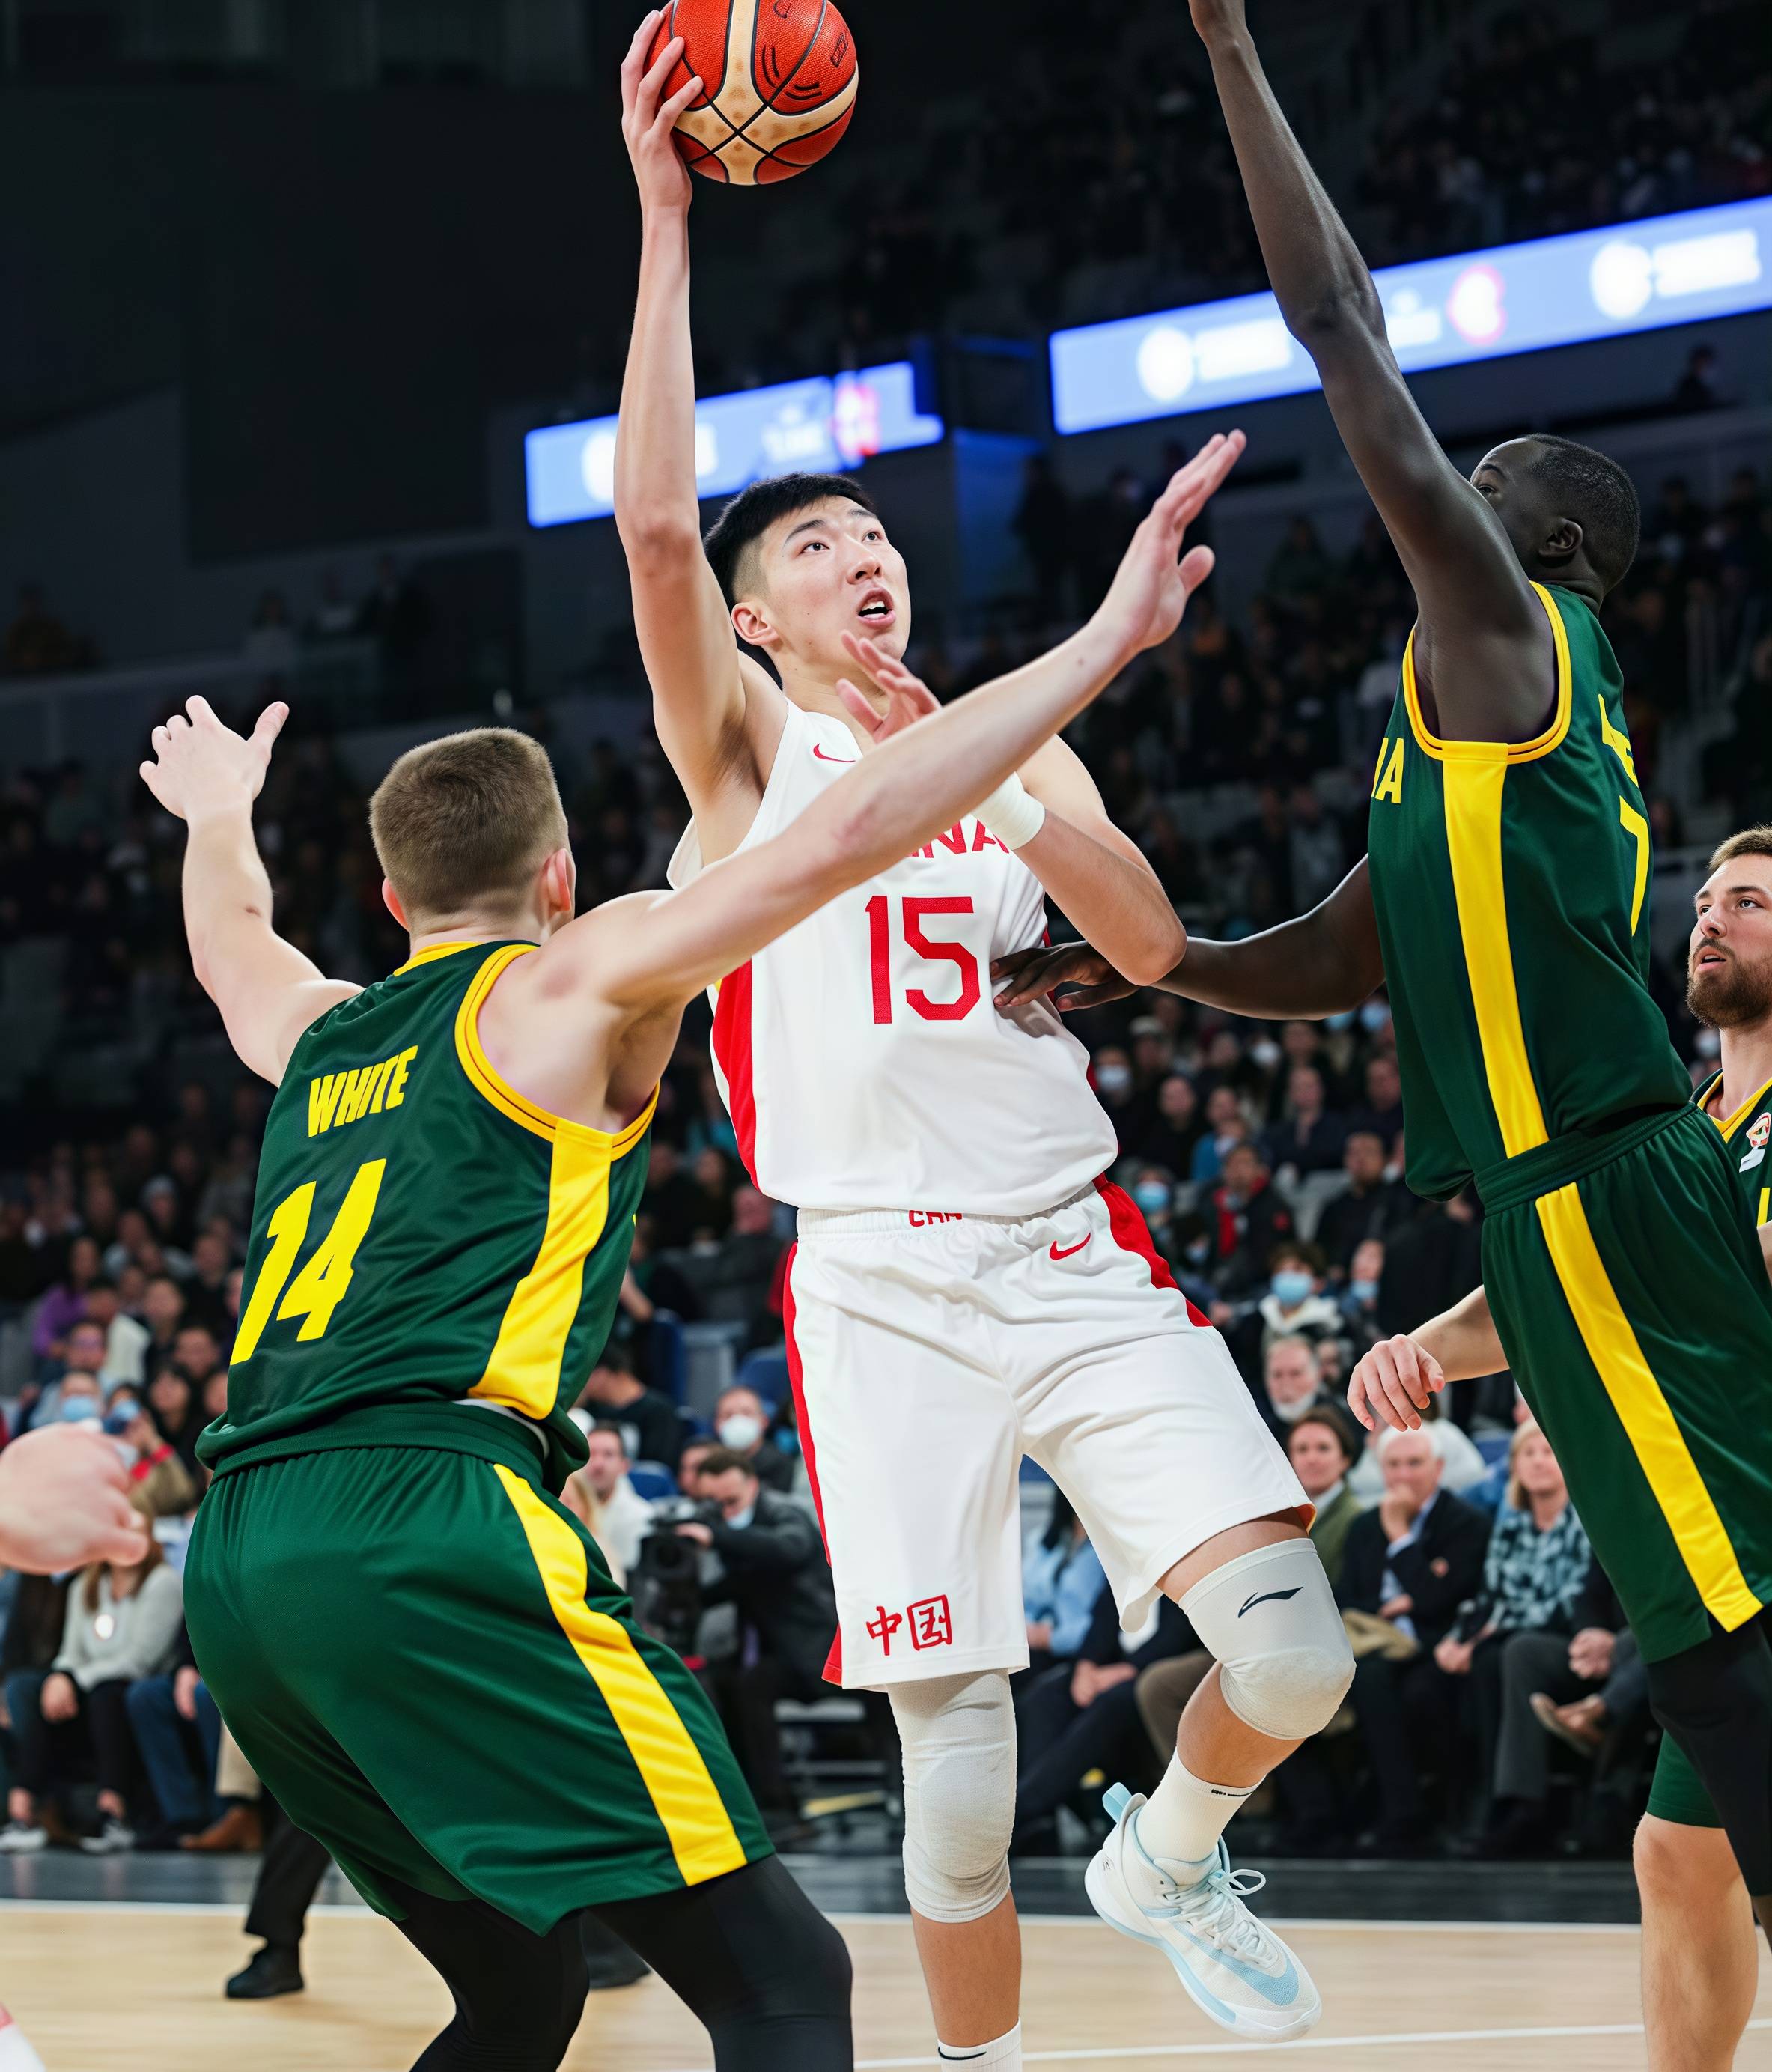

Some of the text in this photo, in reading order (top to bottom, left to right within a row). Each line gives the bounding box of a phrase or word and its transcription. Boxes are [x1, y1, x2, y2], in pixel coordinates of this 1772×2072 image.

[865, 895, 981, 1024] 15
[307, 1044, 419, 1139] WHITE
[229, 1157, 388, 1367] 14
[865, 1594, 954, 1656] 中国
